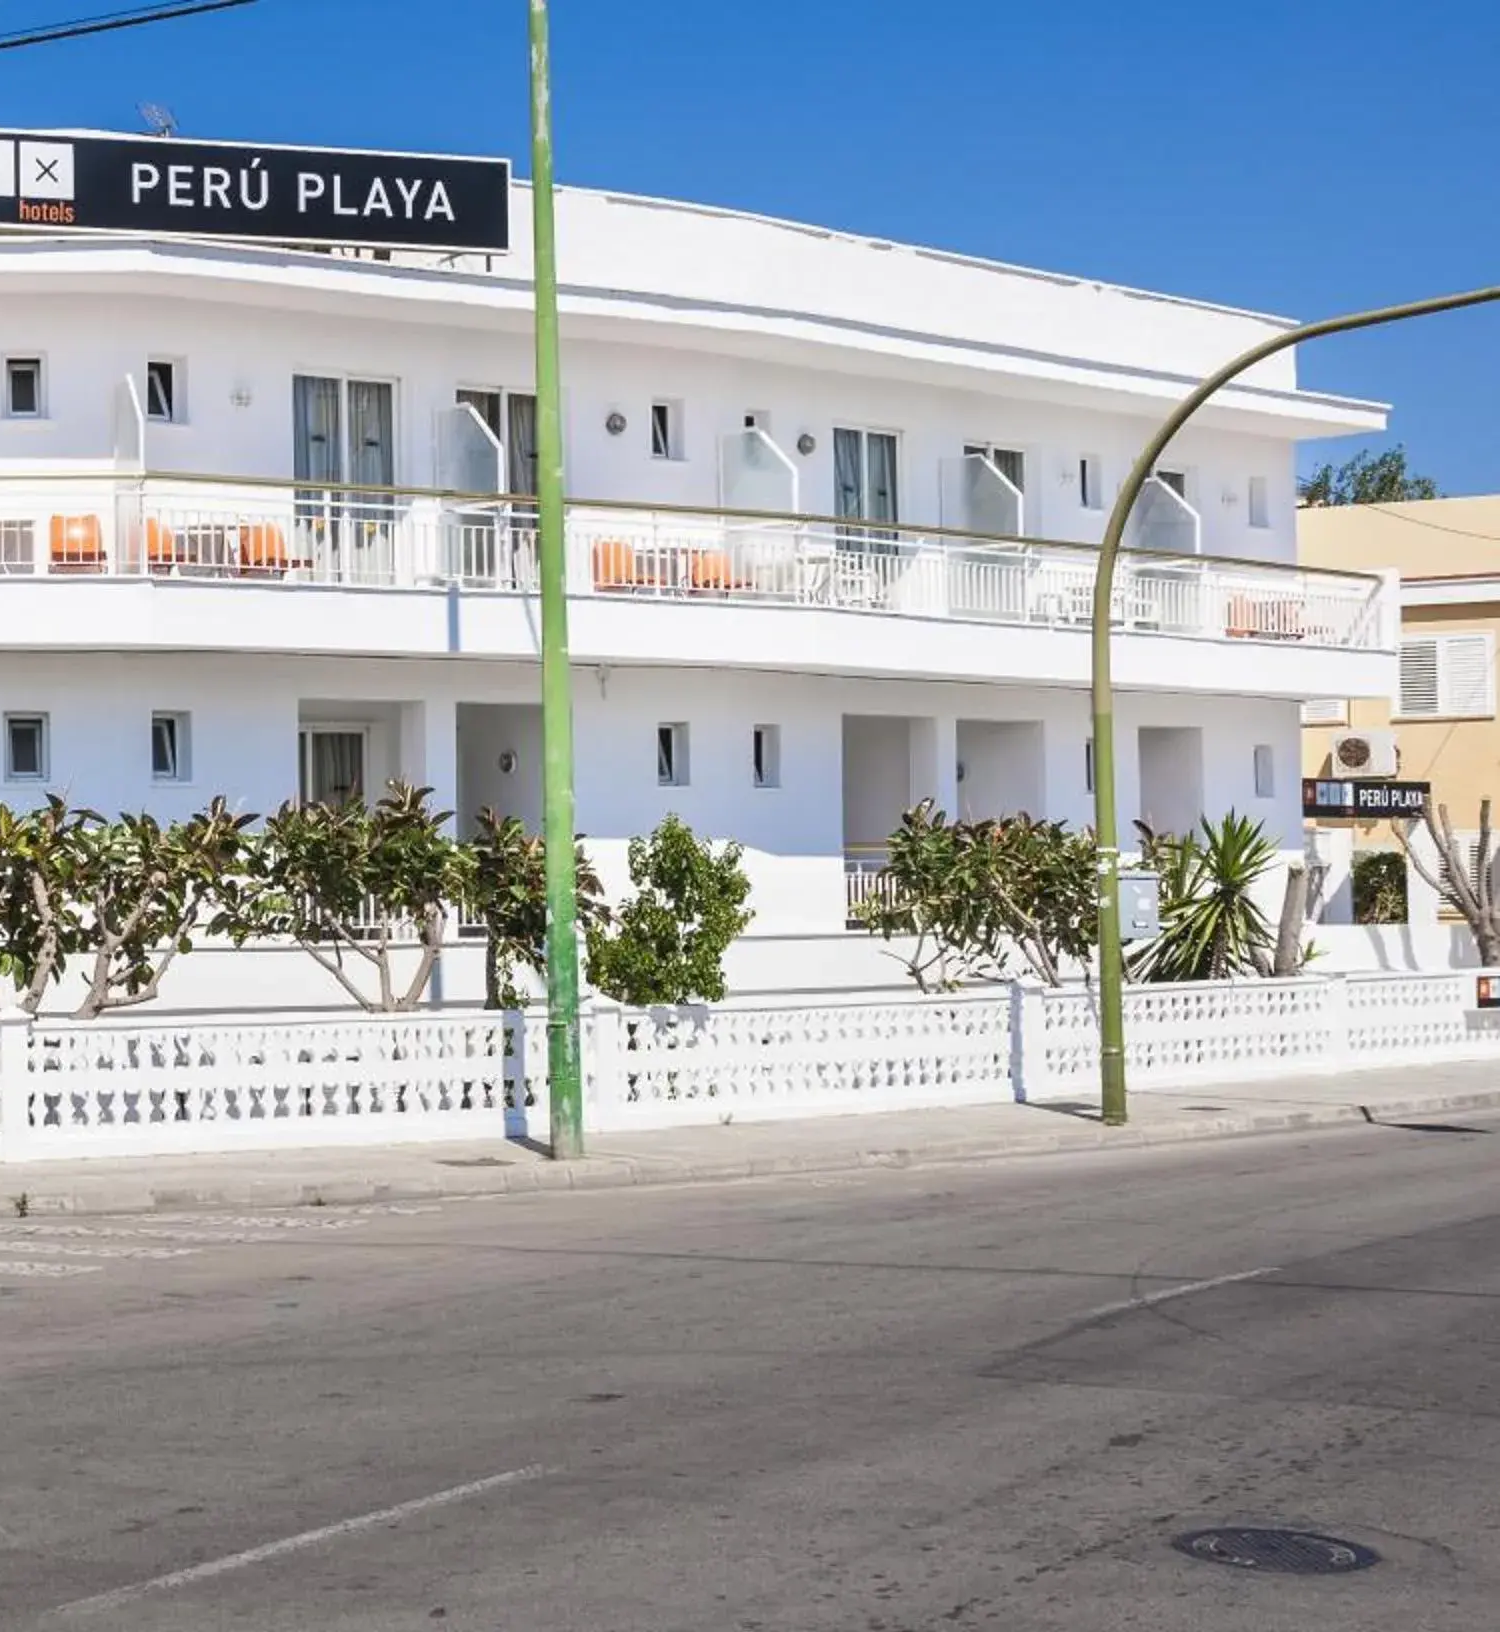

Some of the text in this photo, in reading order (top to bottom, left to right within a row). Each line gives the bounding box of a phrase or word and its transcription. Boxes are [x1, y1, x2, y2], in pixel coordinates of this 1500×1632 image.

[131, 157, 456, 222] PERÚ PLAYA
[18, 200, 75, 223] hotels
[1359, 785, 1388, 807] PERÚ
